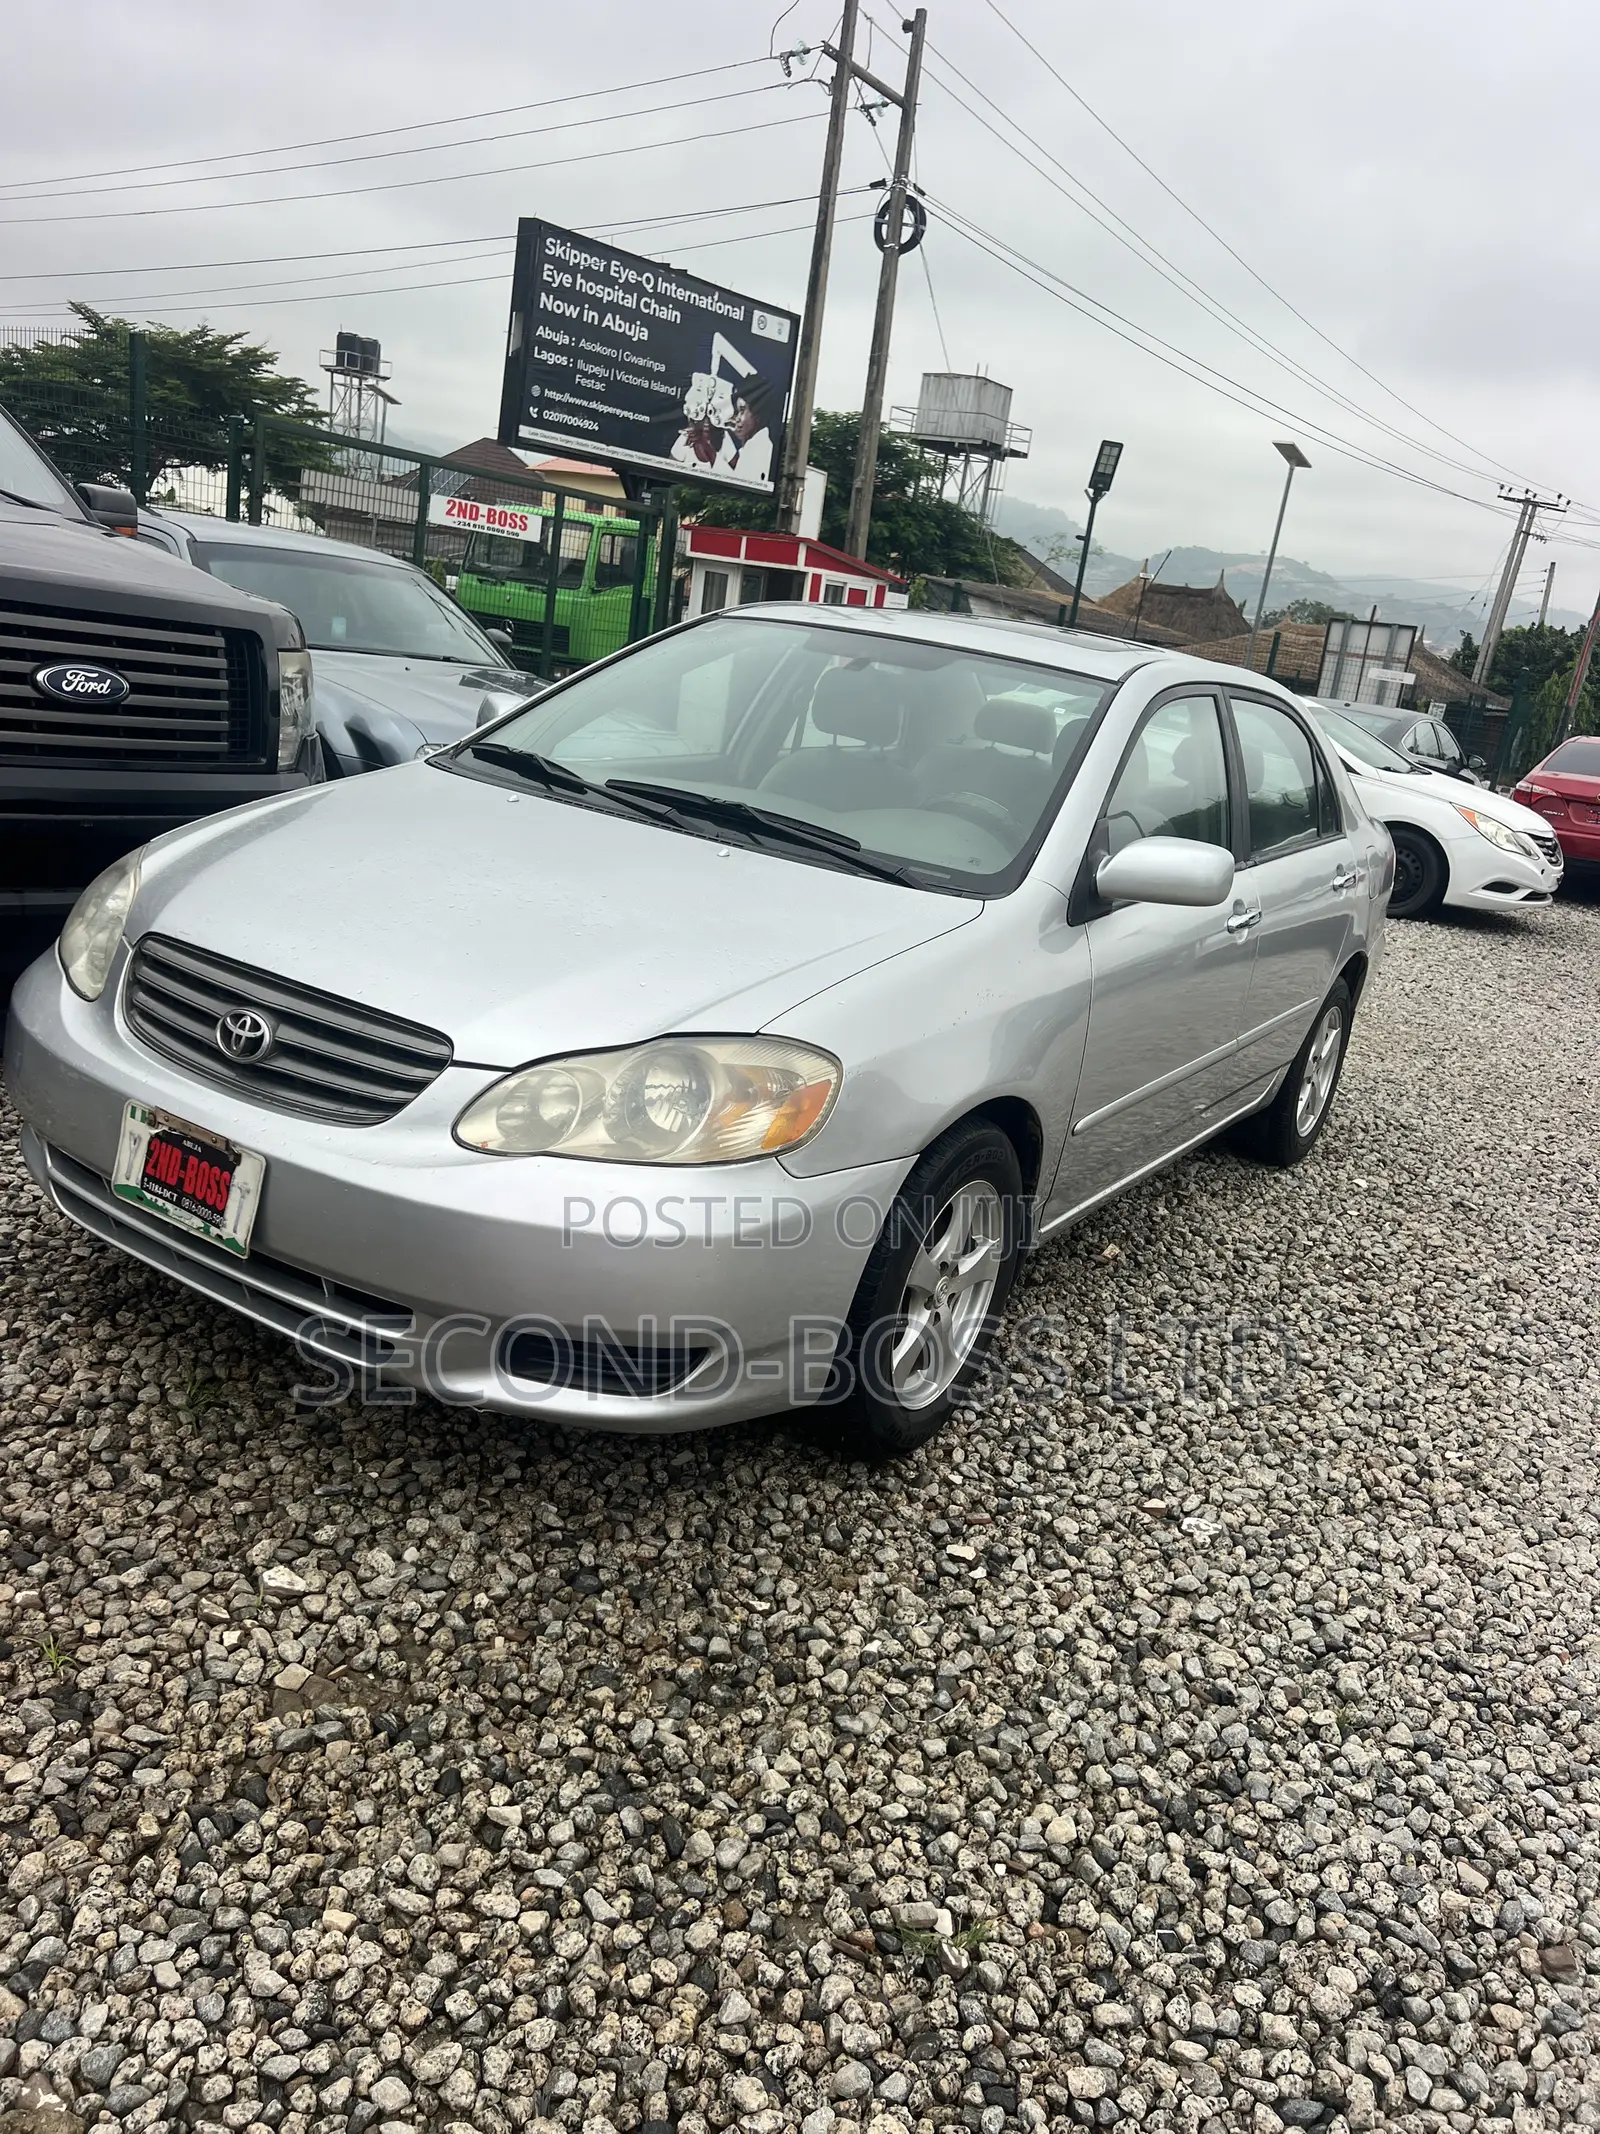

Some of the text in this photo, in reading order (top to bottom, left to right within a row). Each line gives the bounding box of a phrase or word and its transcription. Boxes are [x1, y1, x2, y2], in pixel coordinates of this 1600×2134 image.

[543, 263, 681, 324] Eye hospital Chain
[545, 237, 745, 321] Skipper Eye-Q International
[540, 292, 648, 341] Now in Abuja
[579, 338, 617, 358] Asokoro
[623, 351, 666, 373] Gwarinpa
[575, 374, 606, 391] Festac
[577, 359, 609, 377] Ilupeju
[616, 370, 649, 388] Victoria
[650, 380, 676, 396] Island
[543, 410, 599, 431] 02017004924
[446, 499, 529, 532] 2ND-BOSS
[61, 669, 111, 695] Ford
[146, 1137, 231, 1211] 2ND-BOSS
